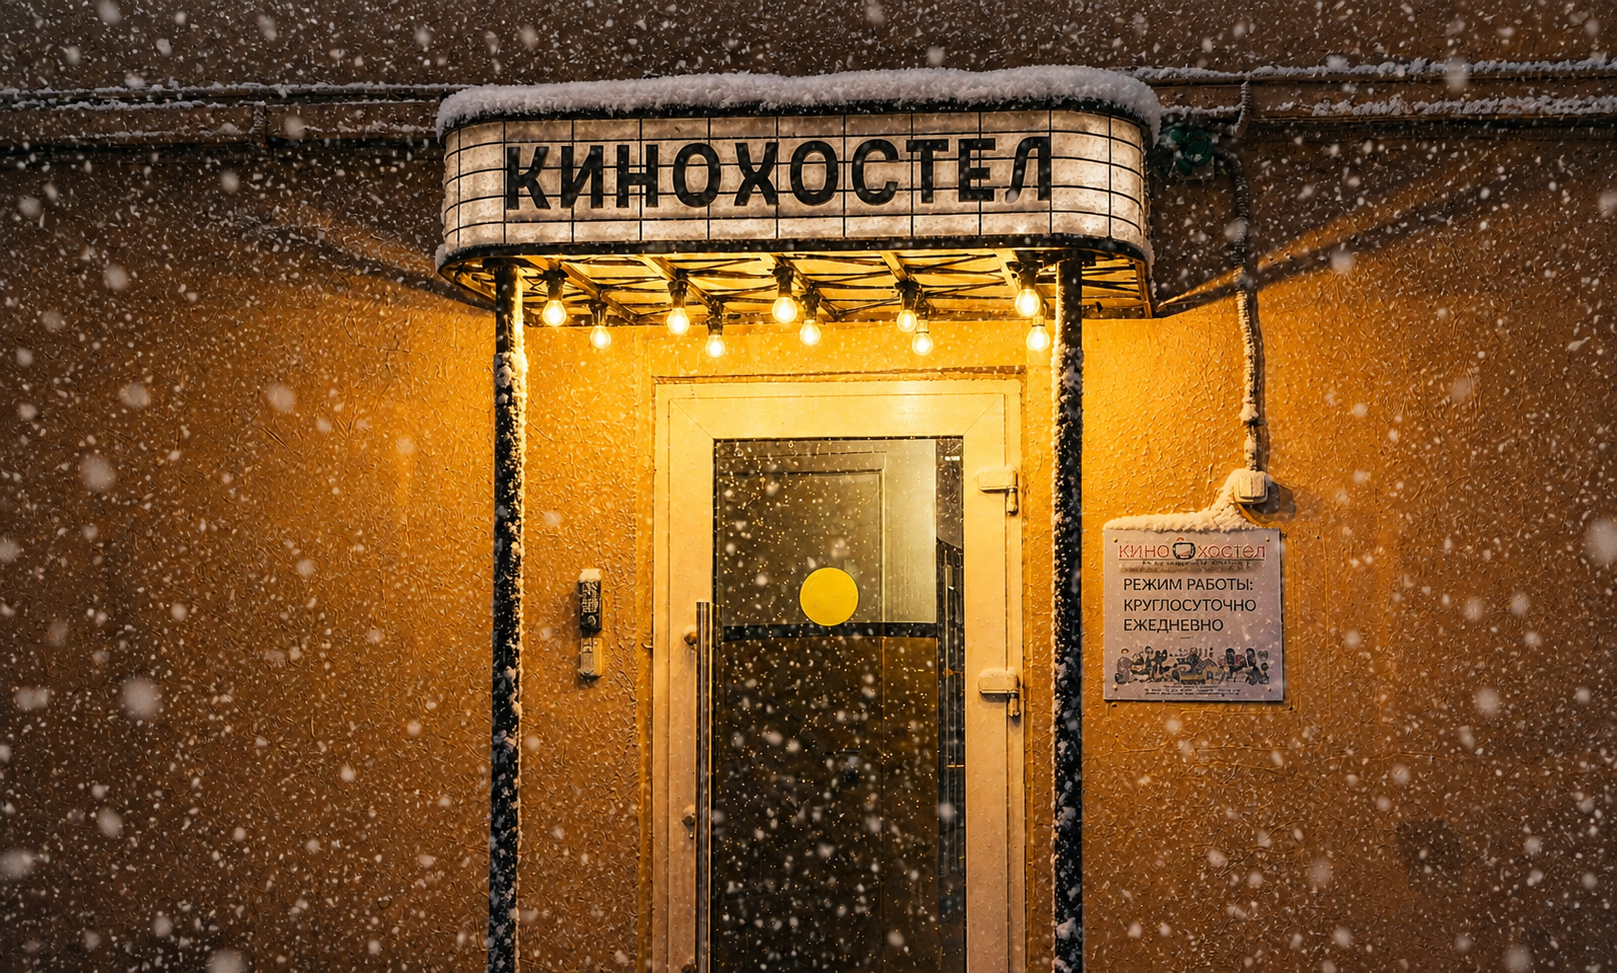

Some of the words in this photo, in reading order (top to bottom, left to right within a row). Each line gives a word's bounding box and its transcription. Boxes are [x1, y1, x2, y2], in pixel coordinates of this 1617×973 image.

[506, 135, 1052, 210] КИНОХОСТЕЛ
[1123, 578, 1182, 591] РЕЖИМ
[1187, 578, 1254, 591] РАБОТЫ:
[1123, 599, 1257, 612] КРУГЛОСУТОЧНО
[1123, 618, 1224, 633] ЕЖЕДНЕВНО
